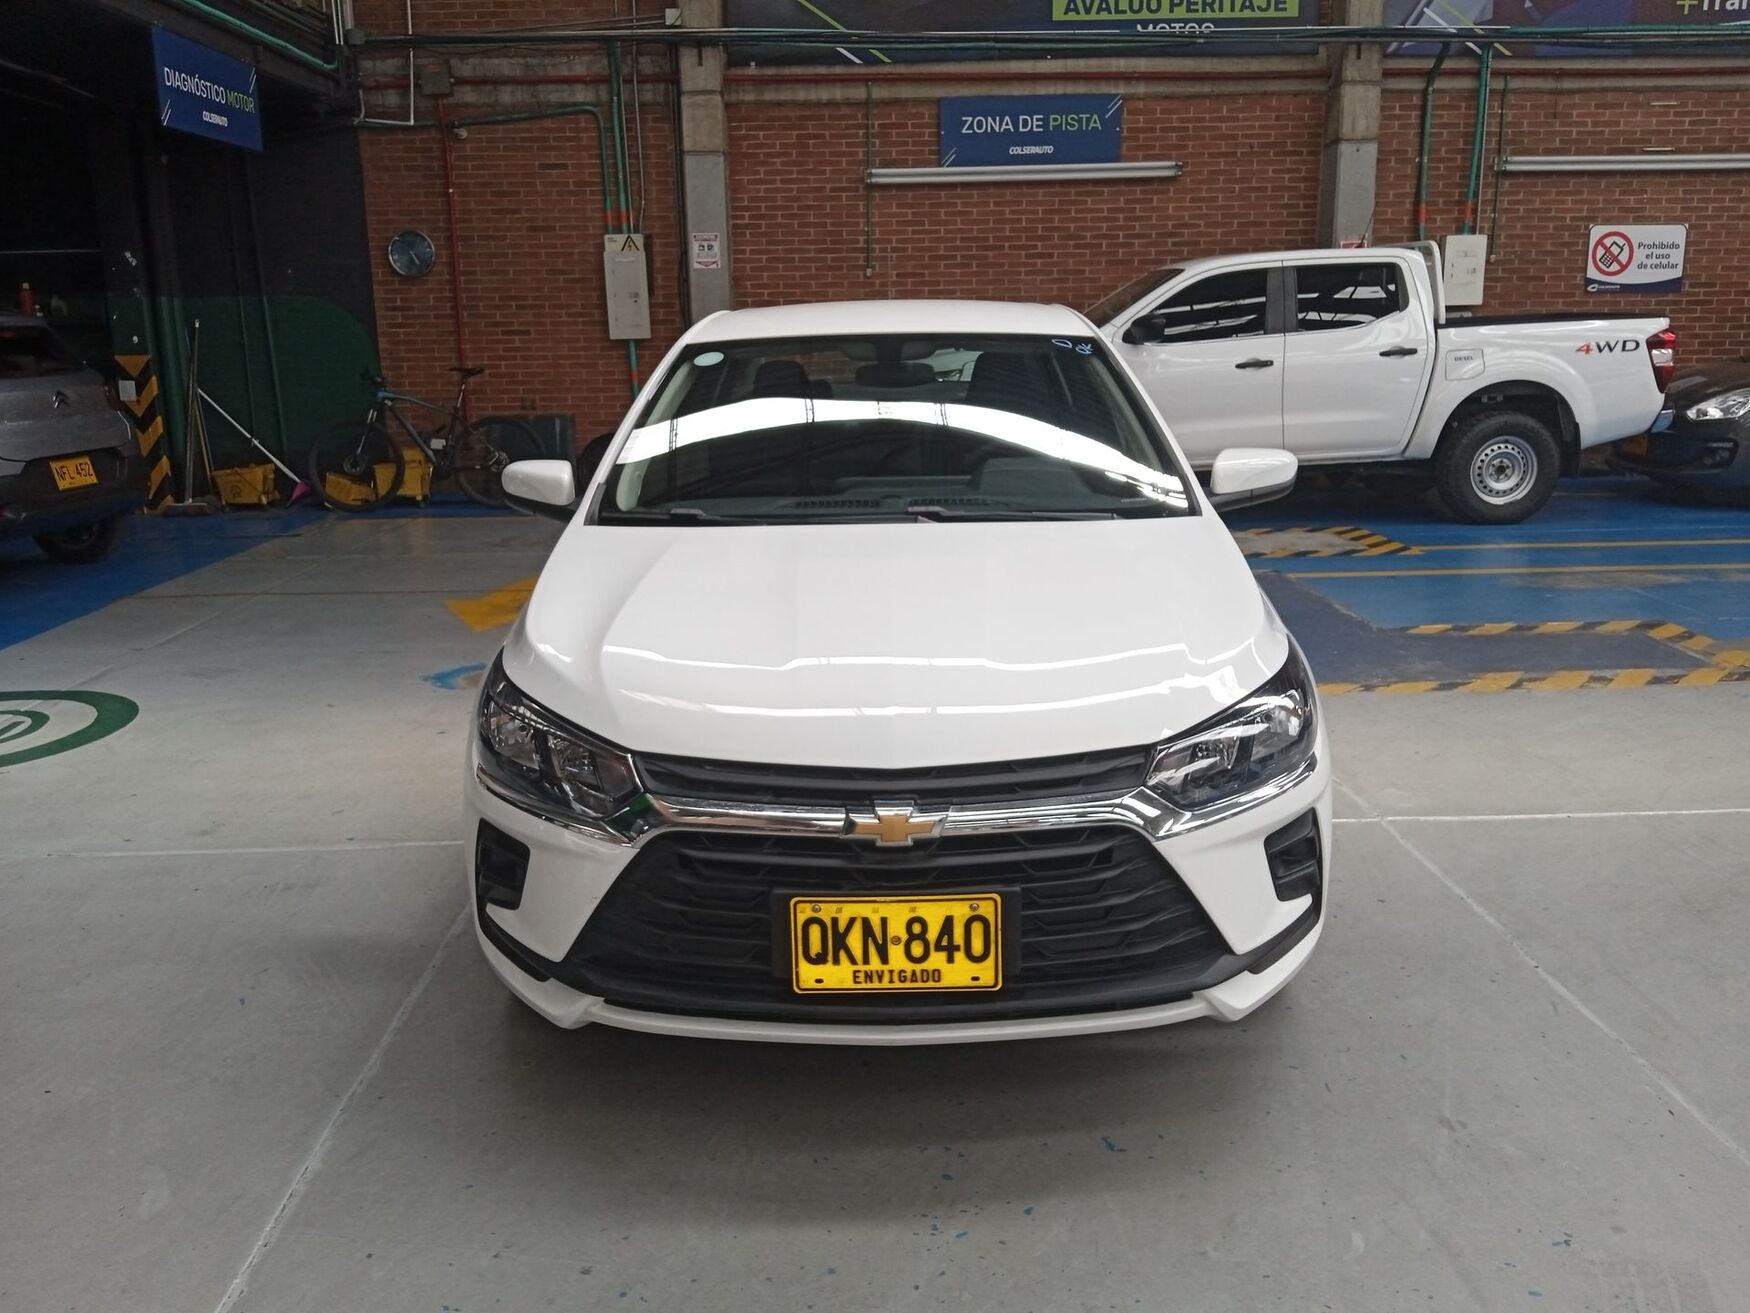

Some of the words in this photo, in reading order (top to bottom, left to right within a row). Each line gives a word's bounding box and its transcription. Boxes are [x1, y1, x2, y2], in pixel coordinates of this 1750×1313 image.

[1168, 0, 1288, 13] PERITAJE
[163, 66, 226, 104] DIAGNÓSTICO
[226, 89, 256, 114] MOTOR
[961, 115, 1014, 134] ZONA
[1019, 115, 1044, 132] DE
[1049, 113, 1102, 132] PISTA
[1008, 145, 1055, 155] COLSERAUTO
[1637, 241, 1681, 250] Prohibido
[1645, 251, 1655, 260] el
[1637, 261, 1649, 270] de
[1649, 261, 1679, 270] celular
[1575, 339, 1641, 355] 4WD
[55, 465, 76, 481] NFL
[75, 462, 94, 478] 452
[801, 916, 890, 966] QKN
[903, 914, 992, 965] 840
[852, 968, 942, 984] ENVIGADO
